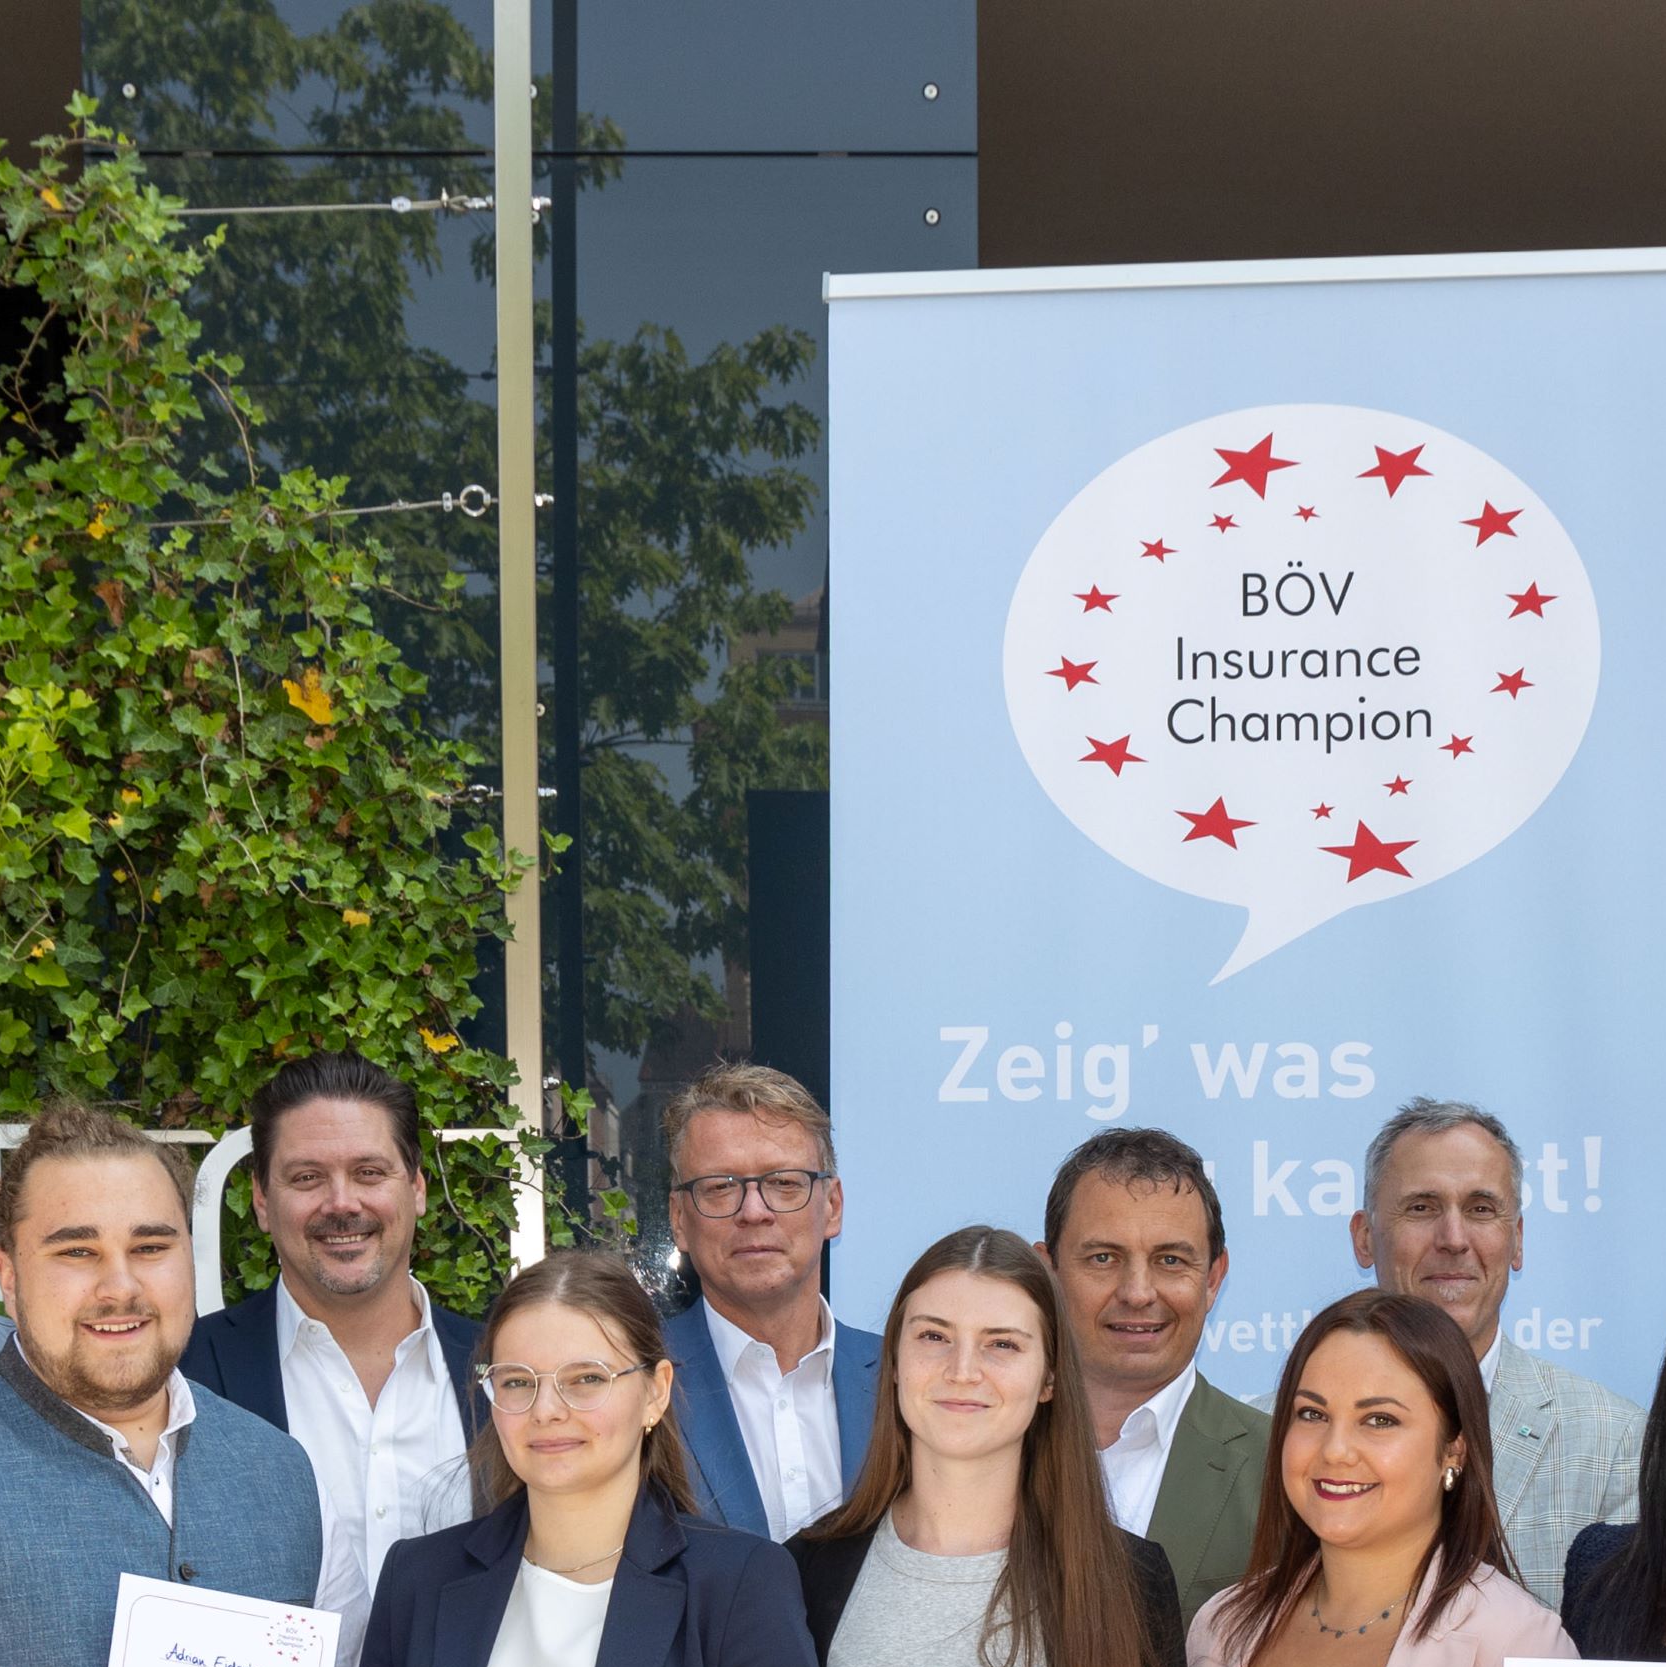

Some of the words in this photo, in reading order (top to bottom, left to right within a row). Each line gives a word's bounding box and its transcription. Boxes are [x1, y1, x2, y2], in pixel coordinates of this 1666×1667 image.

[1240, 559, 1355, 620] BÖV
[1175, 635, 1423, 683] Insurance
[1165, 696, 1435, 753] Champion
[1190, 1041, 1375, 1102] was
[1515, 1308, 1604, 1350] der
[165, 1641, 209, 1667] Adrian
